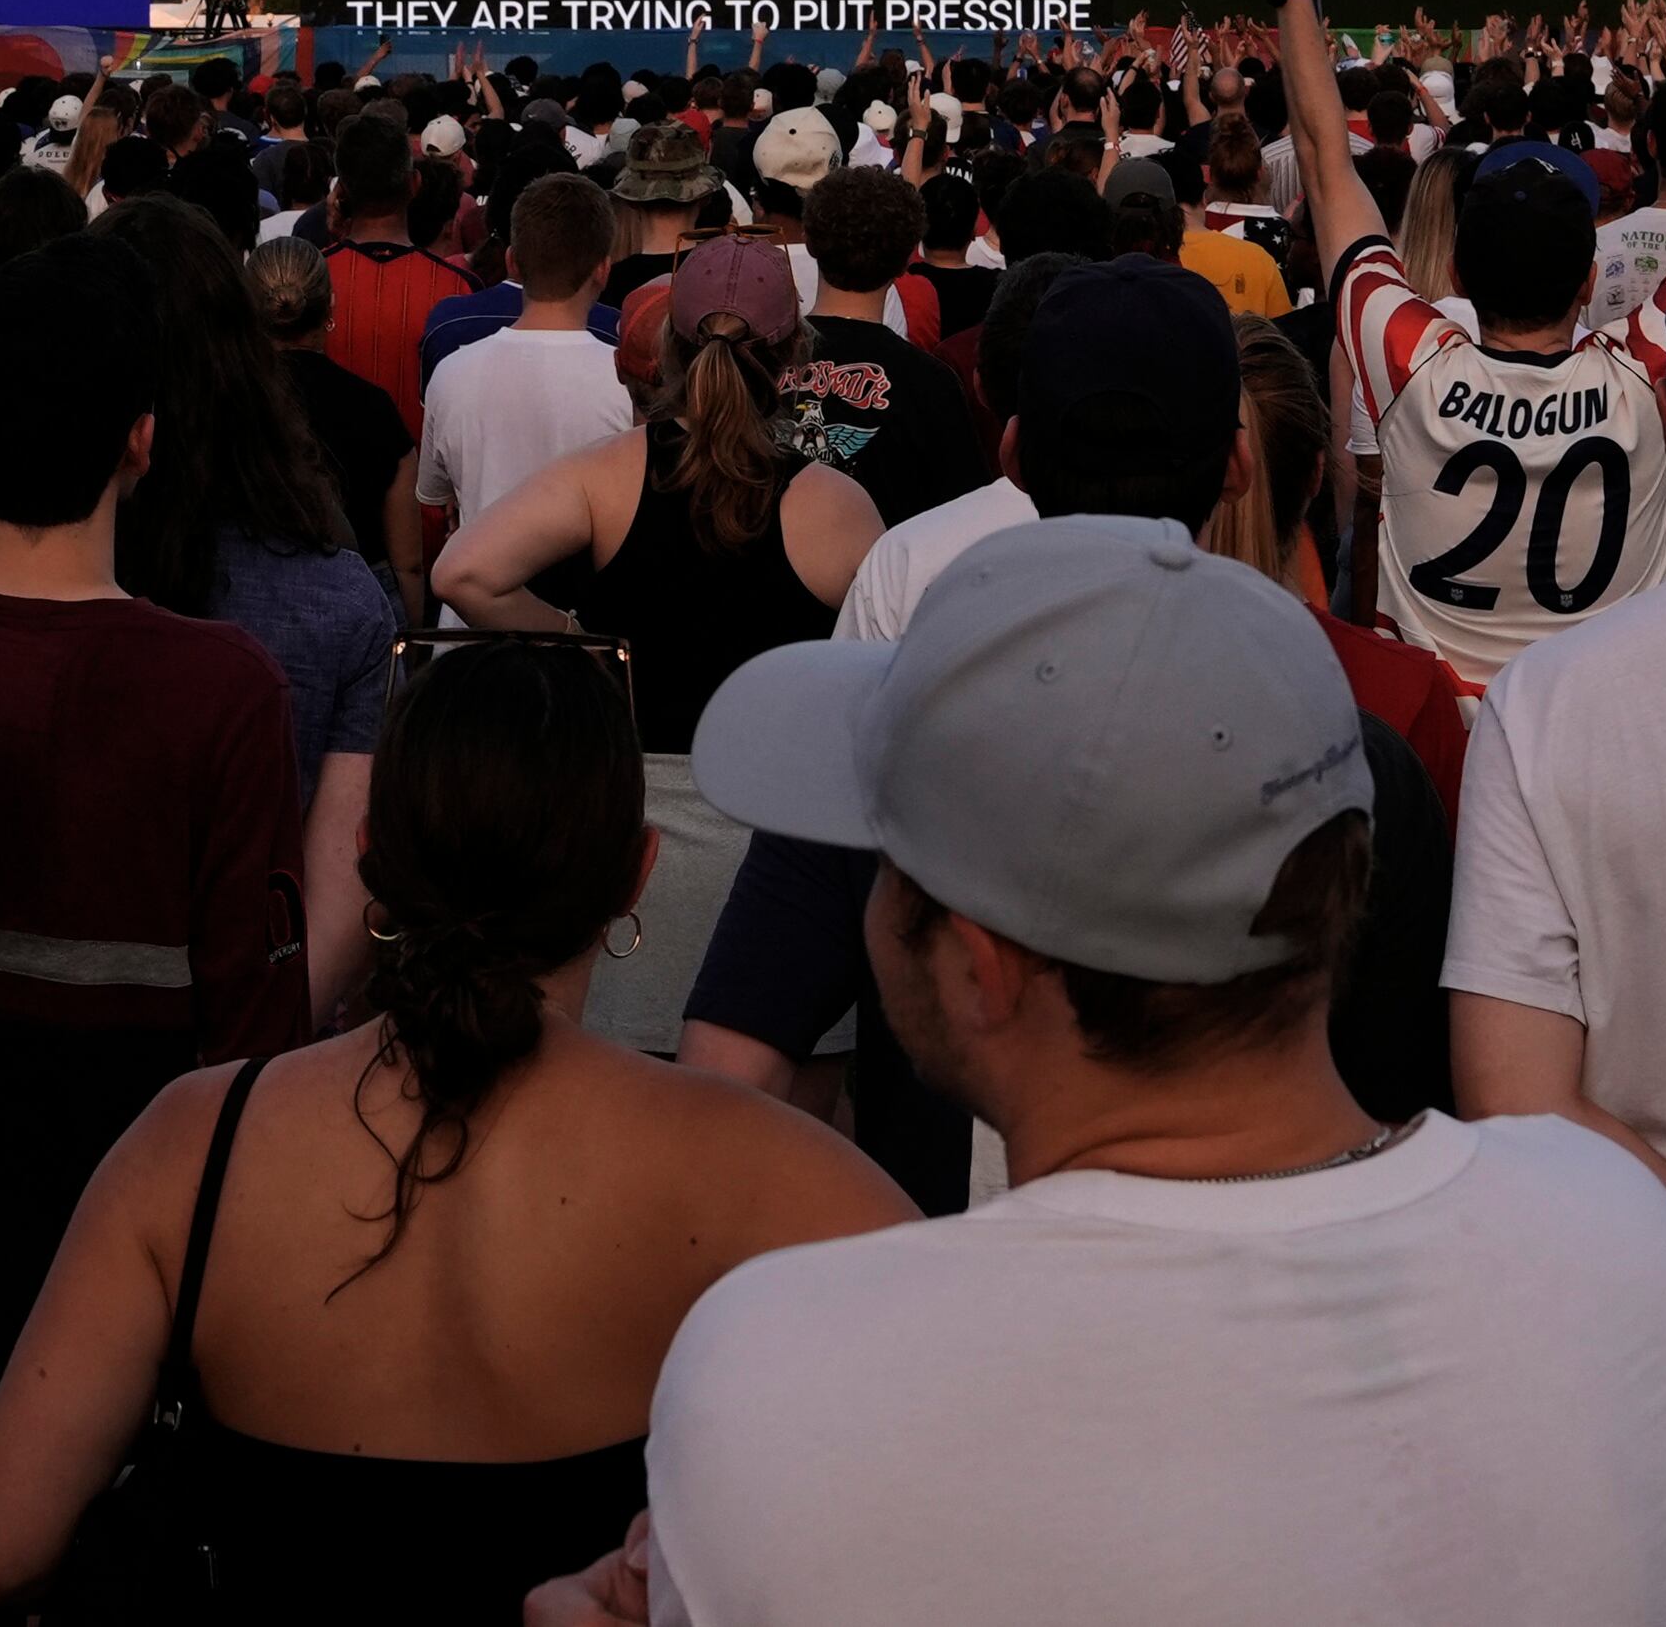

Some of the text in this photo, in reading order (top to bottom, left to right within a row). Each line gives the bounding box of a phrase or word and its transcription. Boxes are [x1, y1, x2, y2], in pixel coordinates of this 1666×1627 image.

[561, 0, 712, 31] TRYING
[725, 0, 780, 31] TO
[794, 0, 874, 31] PUT
[885, 0, 1092, 32] PRESSURE
[1438, 379, 1610, 440] BALOGUN
[1409, 436, 1632, 615] 20
